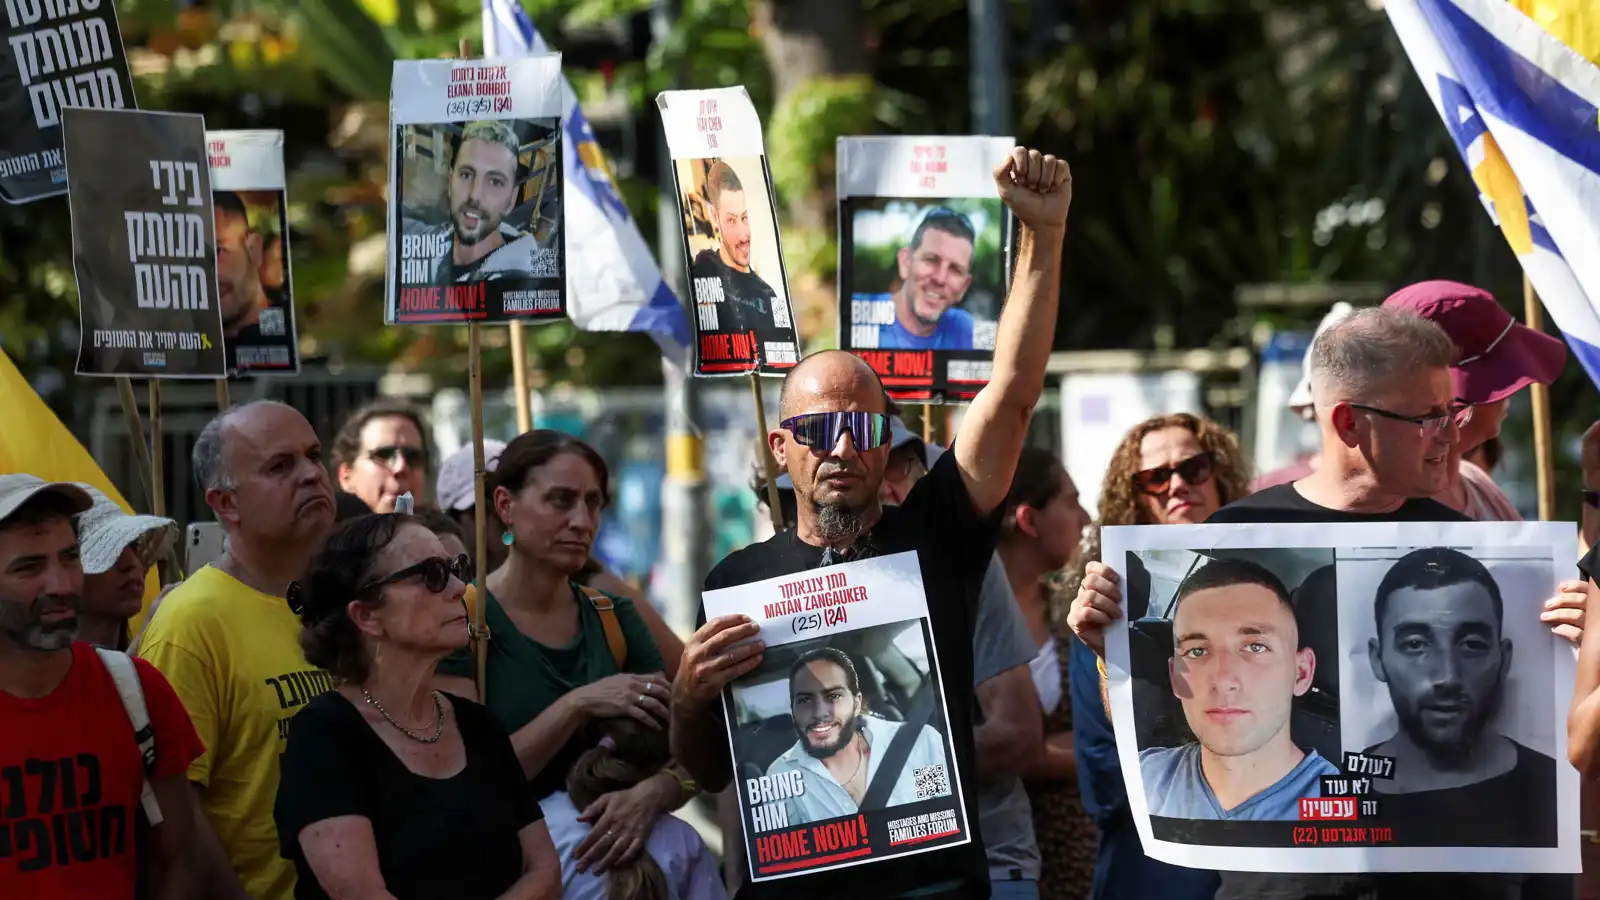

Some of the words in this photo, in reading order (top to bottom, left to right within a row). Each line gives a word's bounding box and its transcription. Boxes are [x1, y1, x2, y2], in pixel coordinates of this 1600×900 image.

[8, 17, 113, 86] מנותק
[28, 67, 125, 129] מהעם
[447, 83, 474, 98] ELKANA
[476, 81, 511, 96] BOHBOT
[446, 101, 465, 116] (36)
[149, 160, 203, 206] ביבי
[124, 211, 205, 263] מנותק
[402, 232, 445, 258] BRING
[401, 259, 428, 284] HIM
[134, 264, 209, 310] מהעם
[401, 287, 440, 311] HOME
[445, 281, 486, 309] NOW!
[694, 277, 725, 303] BRING
[503, 299, 533, 311] FAMILIES
[535, 299, 560, 310] FORUM
[697, 303, 719, 331] HIM
[851, 300, 895, 325] BRING
[93, 329, 137, 349] החטופים
[138, 329, 154, 349] את
[154, 330, 177, 350] יחזיר
[178, 331, 201, 350] העם
[701, 334, 731, 360] HOME
[731, 330, 758, 360] NOW!
[851, 324, 880, 348] HIM
[852, 351, 891, 375] OME
[894, 351, 933, 376] NOW!
[825, 572, 847, 591] מתן
[764, 598, 802, 619] MATAN
[803, 586, 868, 611] ZANGAUKER
[792, 613, 822, 634] (25)
[1347, 754, 1393, 777] לעולם
[0, 753, 101, 819] כולנ
[746, 769, 804, 805] BRING
[1325, 779, 1348, 795] עוד
[1352, 777, 1370, 795] לא
[751, 801, 789, 834] HIM
[887, 816, 917, 830] HOSTAGES
[917, 813, 930, 825] AND
[929, 808, 956, 822] MISSING
[1302, 799, 1354, 818] עכשיו!
[1362, 800, 1377, 815] זה
[756, 828, 811, 864] HOME
[812, 814, 869, 853] NOW!
[889, 823, 927, 843] FAMILIES
[927, 817, 958, 835] FORUM
[1293, 826, 1318, 844] (22)
[1371, 827, 1393, 844] מתן
